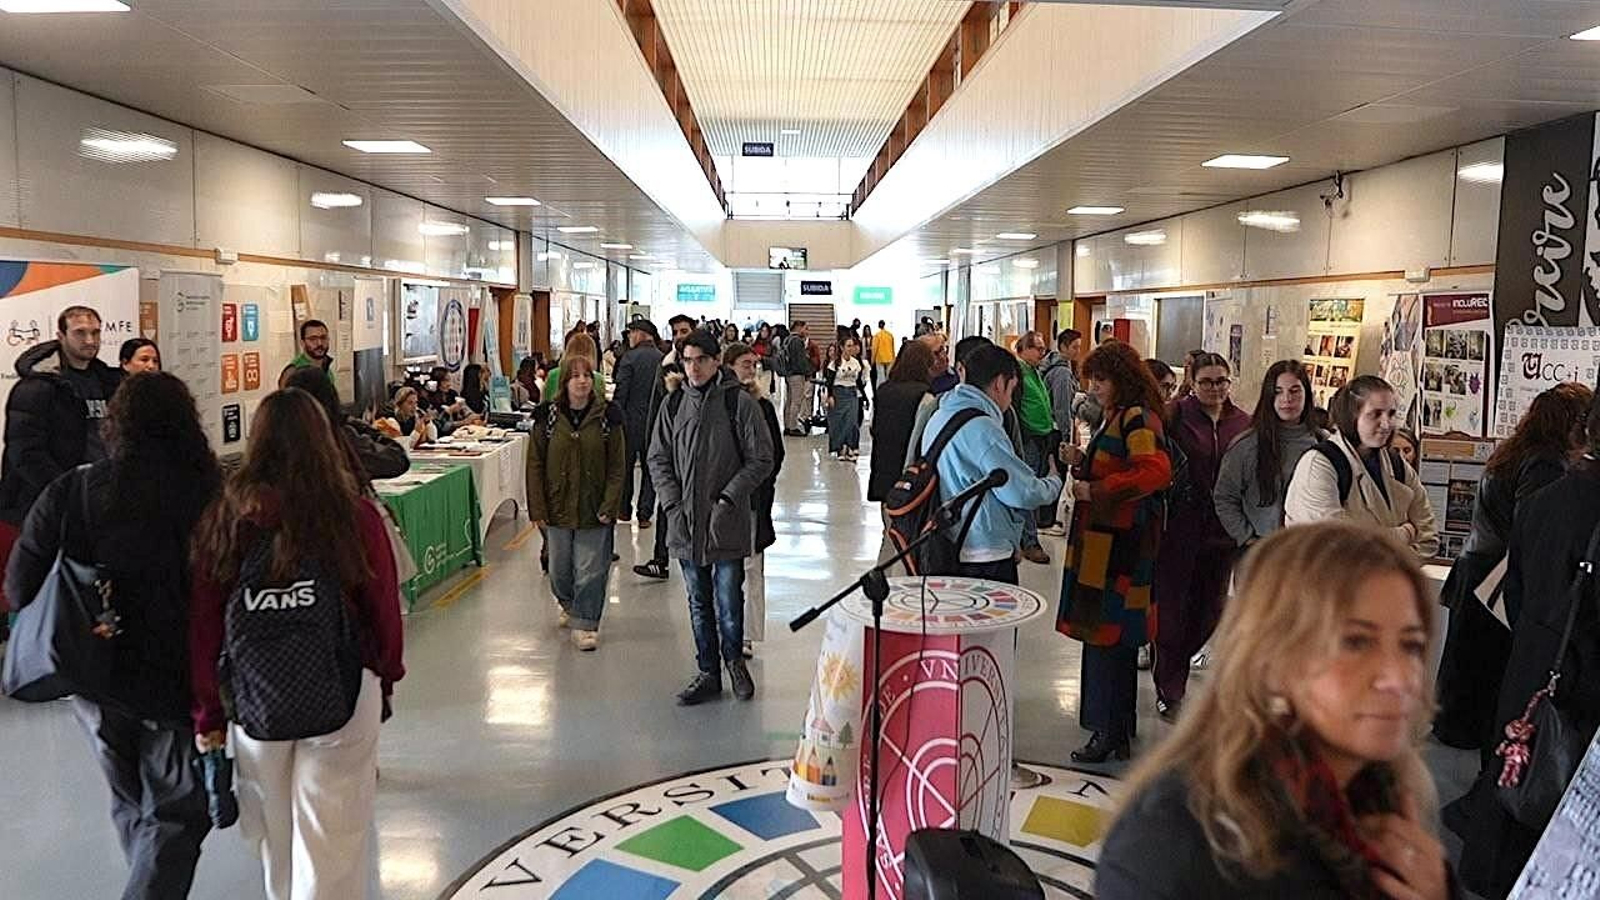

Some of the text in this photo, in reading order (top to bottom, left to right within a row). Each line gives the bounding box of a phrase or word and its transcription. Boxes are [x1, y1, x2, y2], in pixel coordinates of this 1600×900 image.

[744, 145, 772, 155] SUBIDA
[1506, 173, 1575, 329] reire
[803, 284, 829, 292] SUBIDA
[244, 579, 316, 611] VANS
